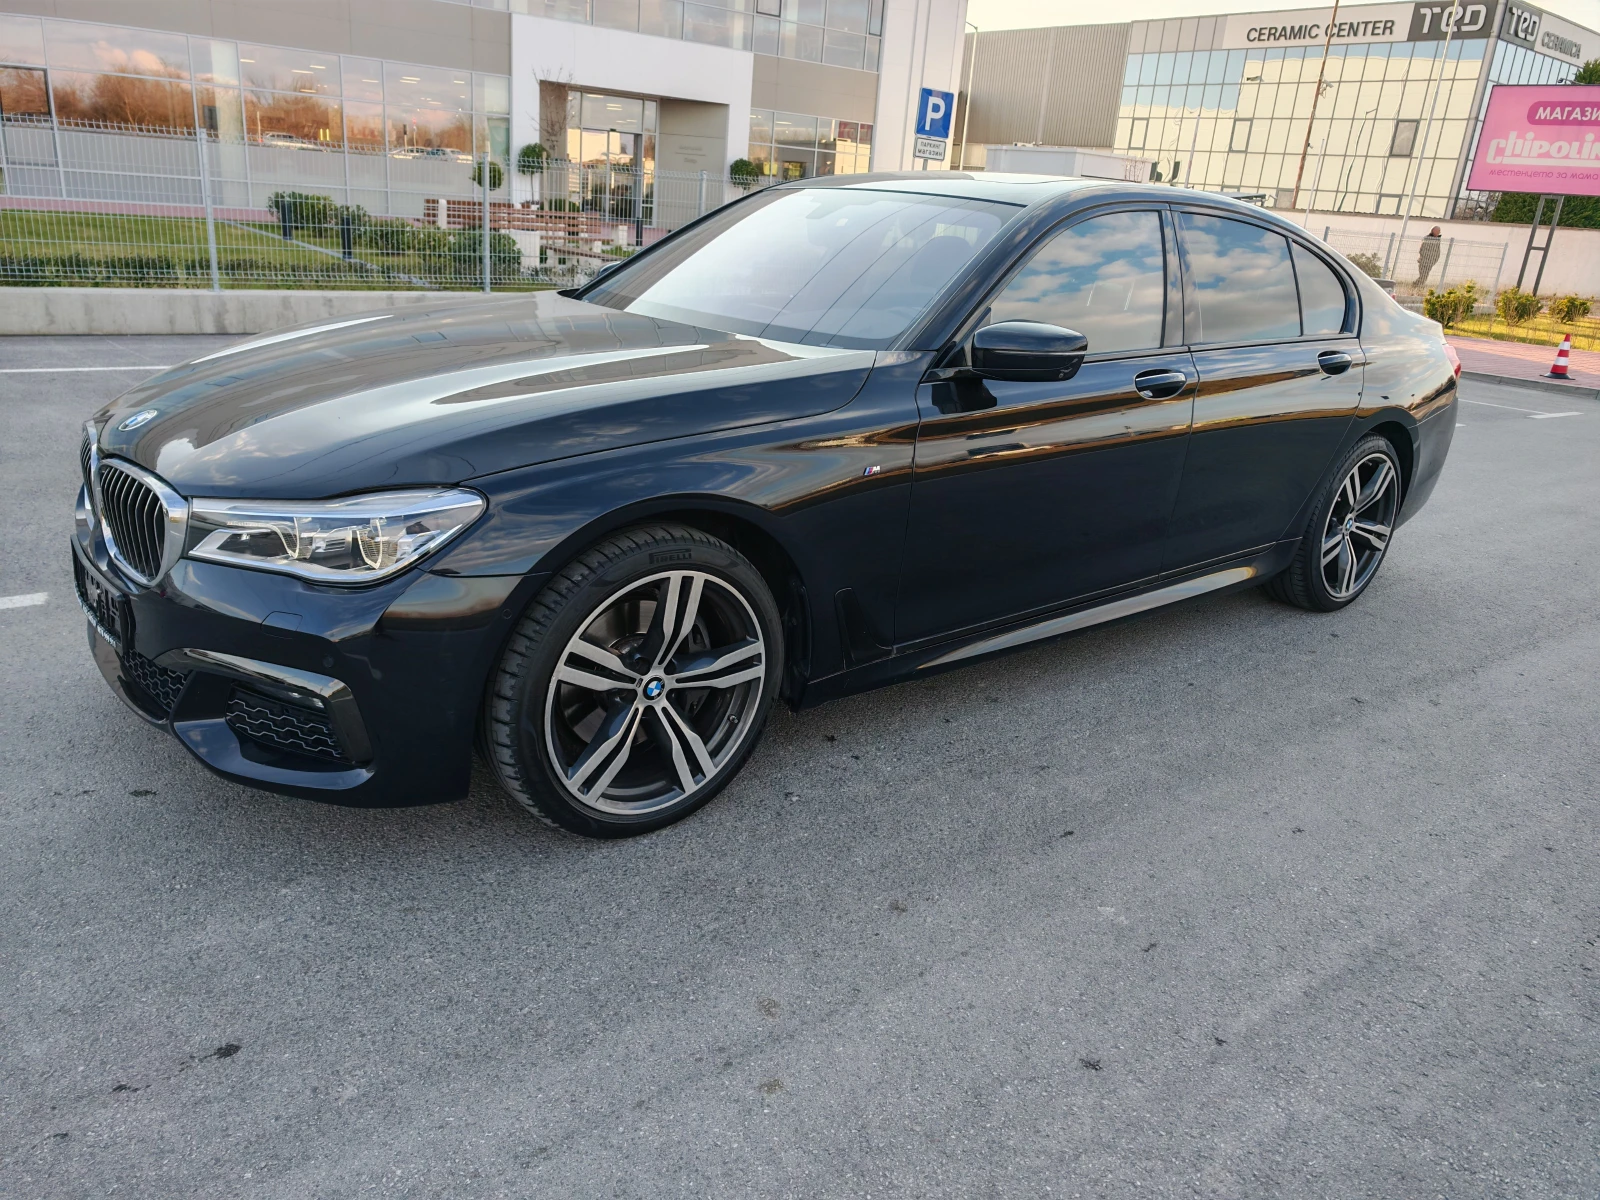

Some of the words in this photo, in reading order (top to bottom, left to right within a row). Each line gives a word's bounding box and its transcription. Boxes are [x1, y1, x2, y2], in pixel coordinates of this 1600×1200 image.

[1246, 24, 1320, 42] CERAMIC
[1324, 20, 1395, 38] CENTER
[1541, 30, 1582, 60] CERAMICA
[924, 96, 946, 131] P
[1569, 172, 1599, 180] мама
[648, 549, 692, 564] PIRELLI
